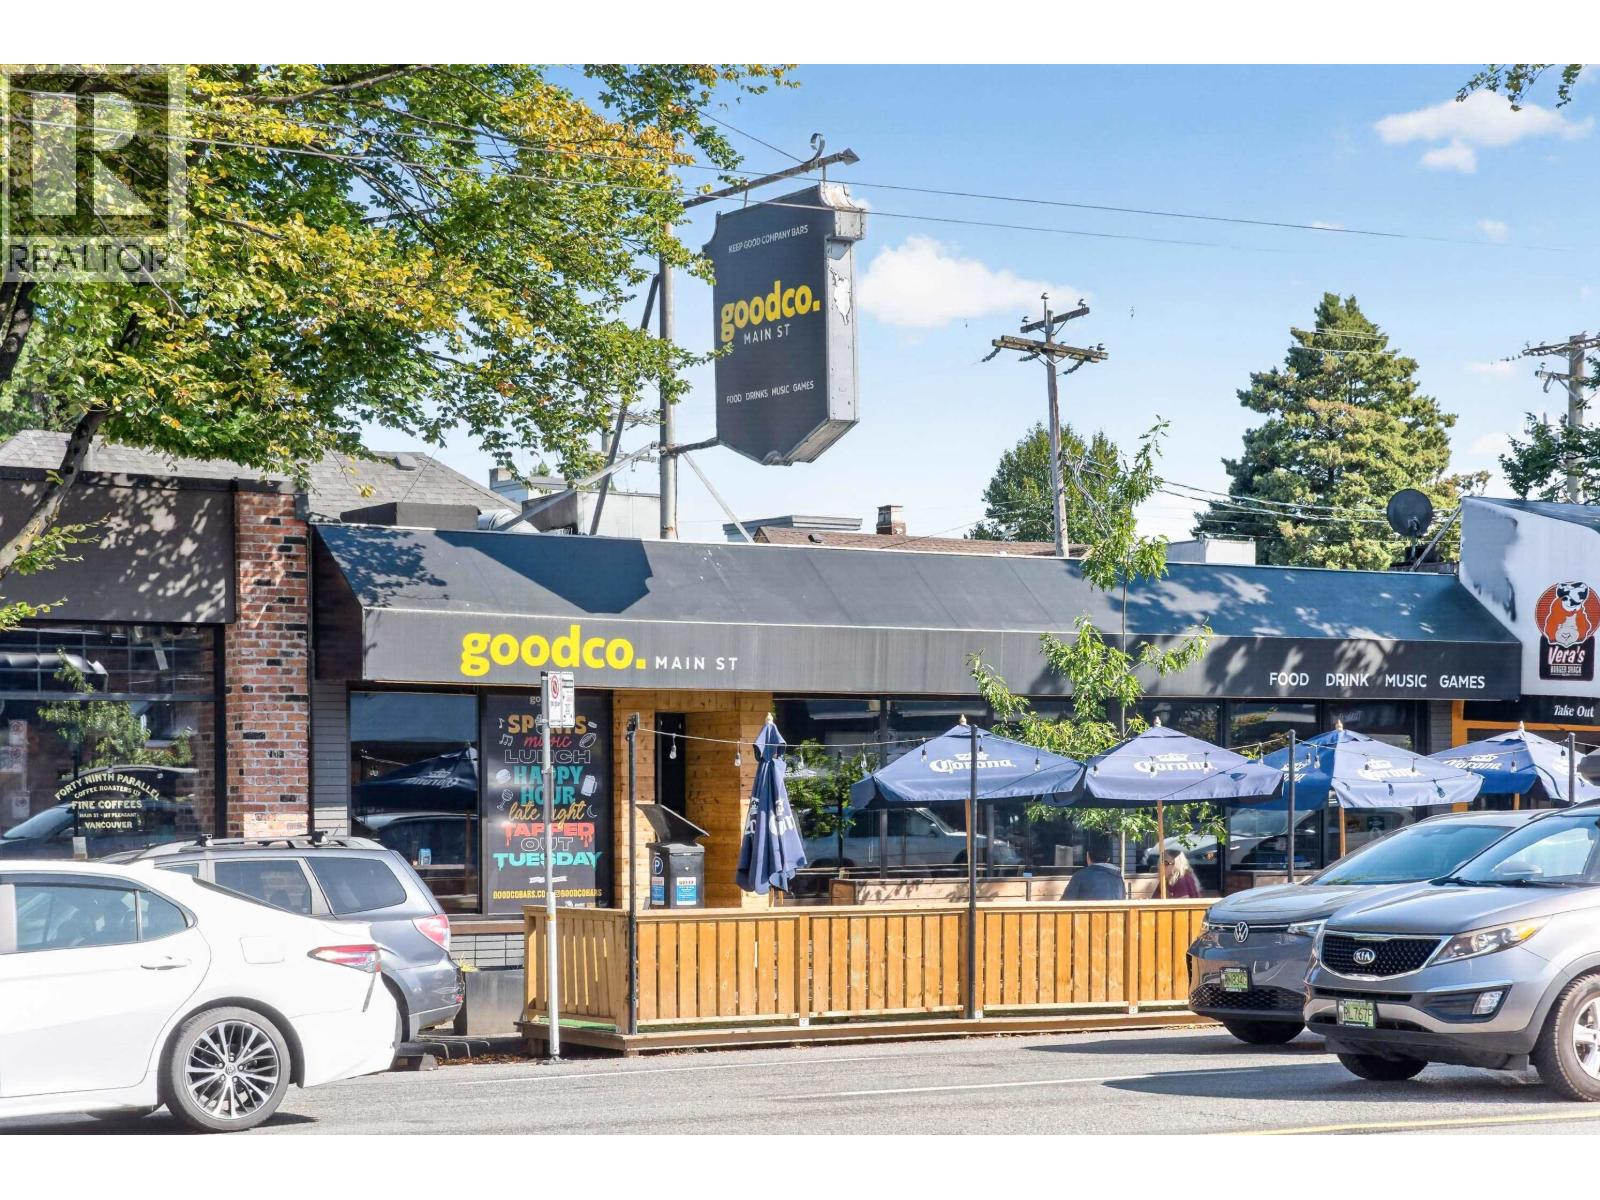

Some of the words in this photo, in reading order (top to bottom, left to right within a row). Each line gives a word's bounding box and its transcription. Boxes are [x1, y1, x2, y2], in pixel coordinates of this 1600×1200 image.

[728, 242, 743, 253] KEEP
[744, 237, 761, 249] GOOD
[761, 229, 791, 244] COMPANY
[791, 224, 809, 237] BARS
[720, 280, 820, 343] goodco.
[743, 328, 772, 345] MAIN
[776, 323, 791, 339] ST
[726, 393, 742, 404] FOOD
[745, 389, 768, 400] DRINKS
[771, 384, 790, 396] MUSIC
[793, 380, 815, 392] GAMES
[460, 624, 647, 677] goodco.
[655, 656, 705, 670] MAIN
[716, 656, 739, 670] ST
[1548, 646, 1586, 665] Vera's
[1269, 672, 1310, 686] FOOD
[1325, 673, 1369, 687] DRINK
[1385, 674, 1427, 688] MUSIC
[1439, 675, 1486, 689] GAMES
[1554, 705, 1575, 717] Take
[1577, 705, 1595, 718] Out
[507, 714, 587, 734] SPS
[524, 735, 573, 748] muic
[513, 765, 584, 785] HAPY
[929, 759, 1013, 774] Corona
[54, 778, 82, 800] FORTY
[84, 773, 114, 784] NINTH
[117, 773, 160, 801] PARALLEL
[74, 786, 98, 799] COFFEE
[99, 785, 132, 794] ROASTERS
[71, 800, 96, 810] FINE
[98, 800, 143, 810] COFFEES
[508, 801, 541, 821] late
[543, 800, 586, 830] ight
[84, 821, 133, 829] VANCOUVER
[493, 889, 551, 899] GOODCOBARS.CO
